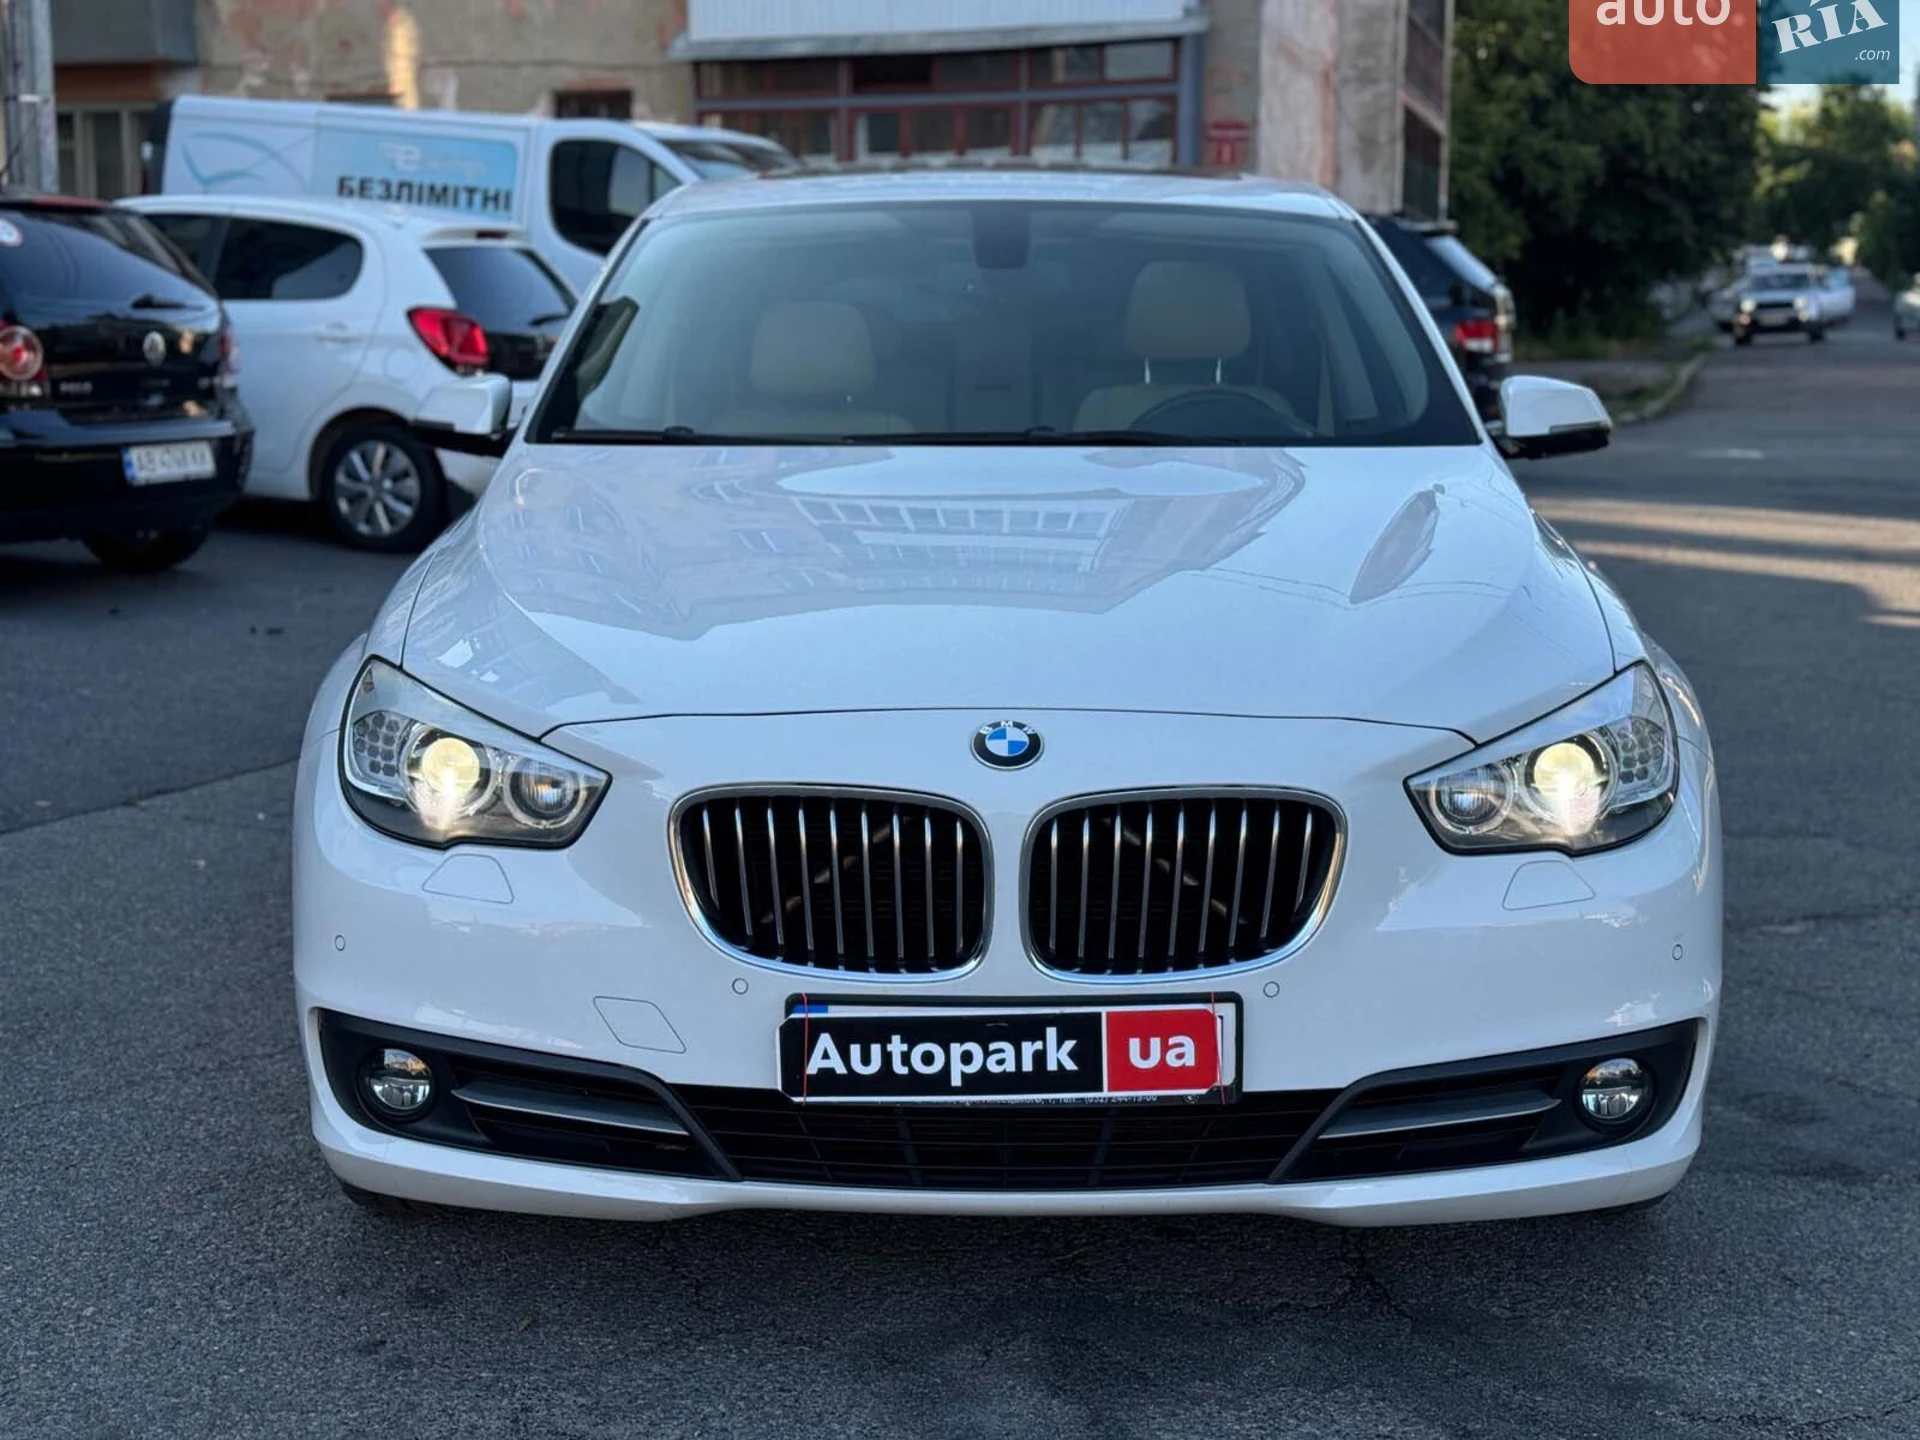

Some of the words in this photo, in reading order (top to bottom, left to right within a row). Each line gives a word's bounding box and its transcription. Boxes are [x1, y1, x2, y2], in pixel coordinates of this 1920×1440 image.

[338, 175, 512, 211] БЕЗЛІМІТНІ
[980, 720, 1036, 734] BMW
[806, 1027, 1078, 1086] Autopark
[1128, 1034, 1195, 1069] ua
